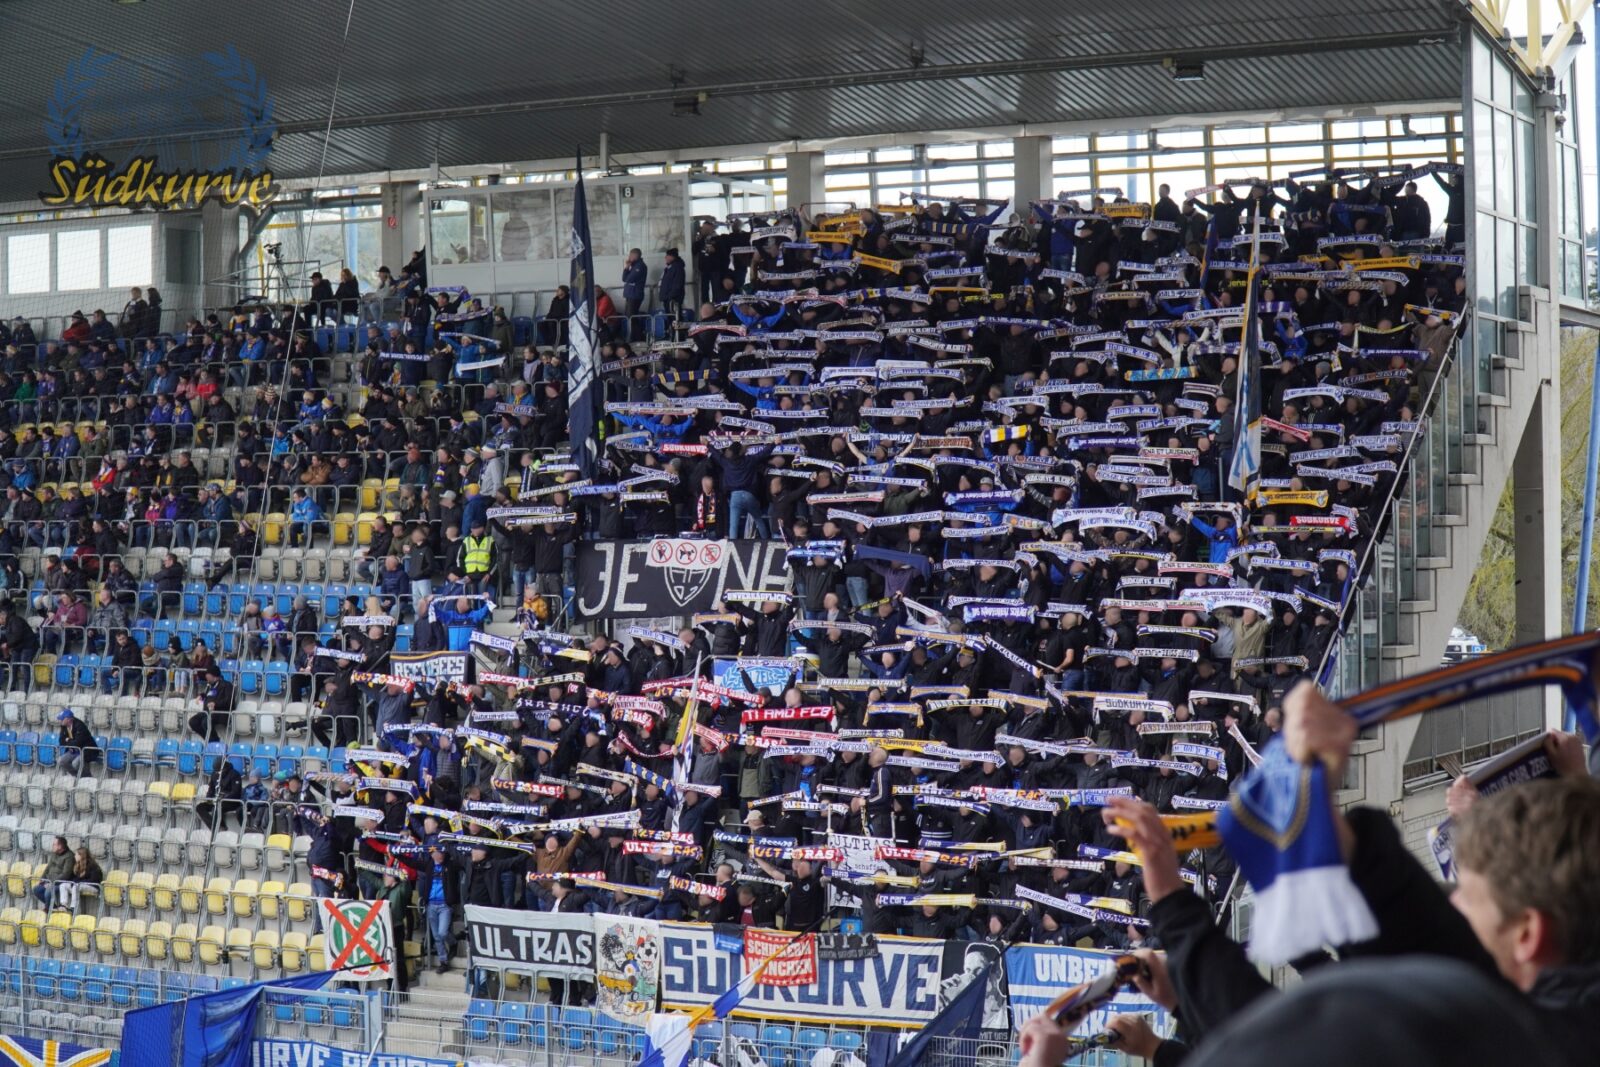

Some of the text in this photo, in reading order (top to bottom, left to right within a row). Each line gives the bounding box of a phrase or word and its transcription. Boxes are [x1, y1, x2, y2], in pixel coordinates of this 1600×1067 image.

[623, 187, 632, 198] 8
[432, 200, 441, 210] 7
[744, 706, 832, 720] TI AMO FCB
[472, 924, 593, 965] ULTRAS
[662, 935, 940, 1012] SÜURVE
